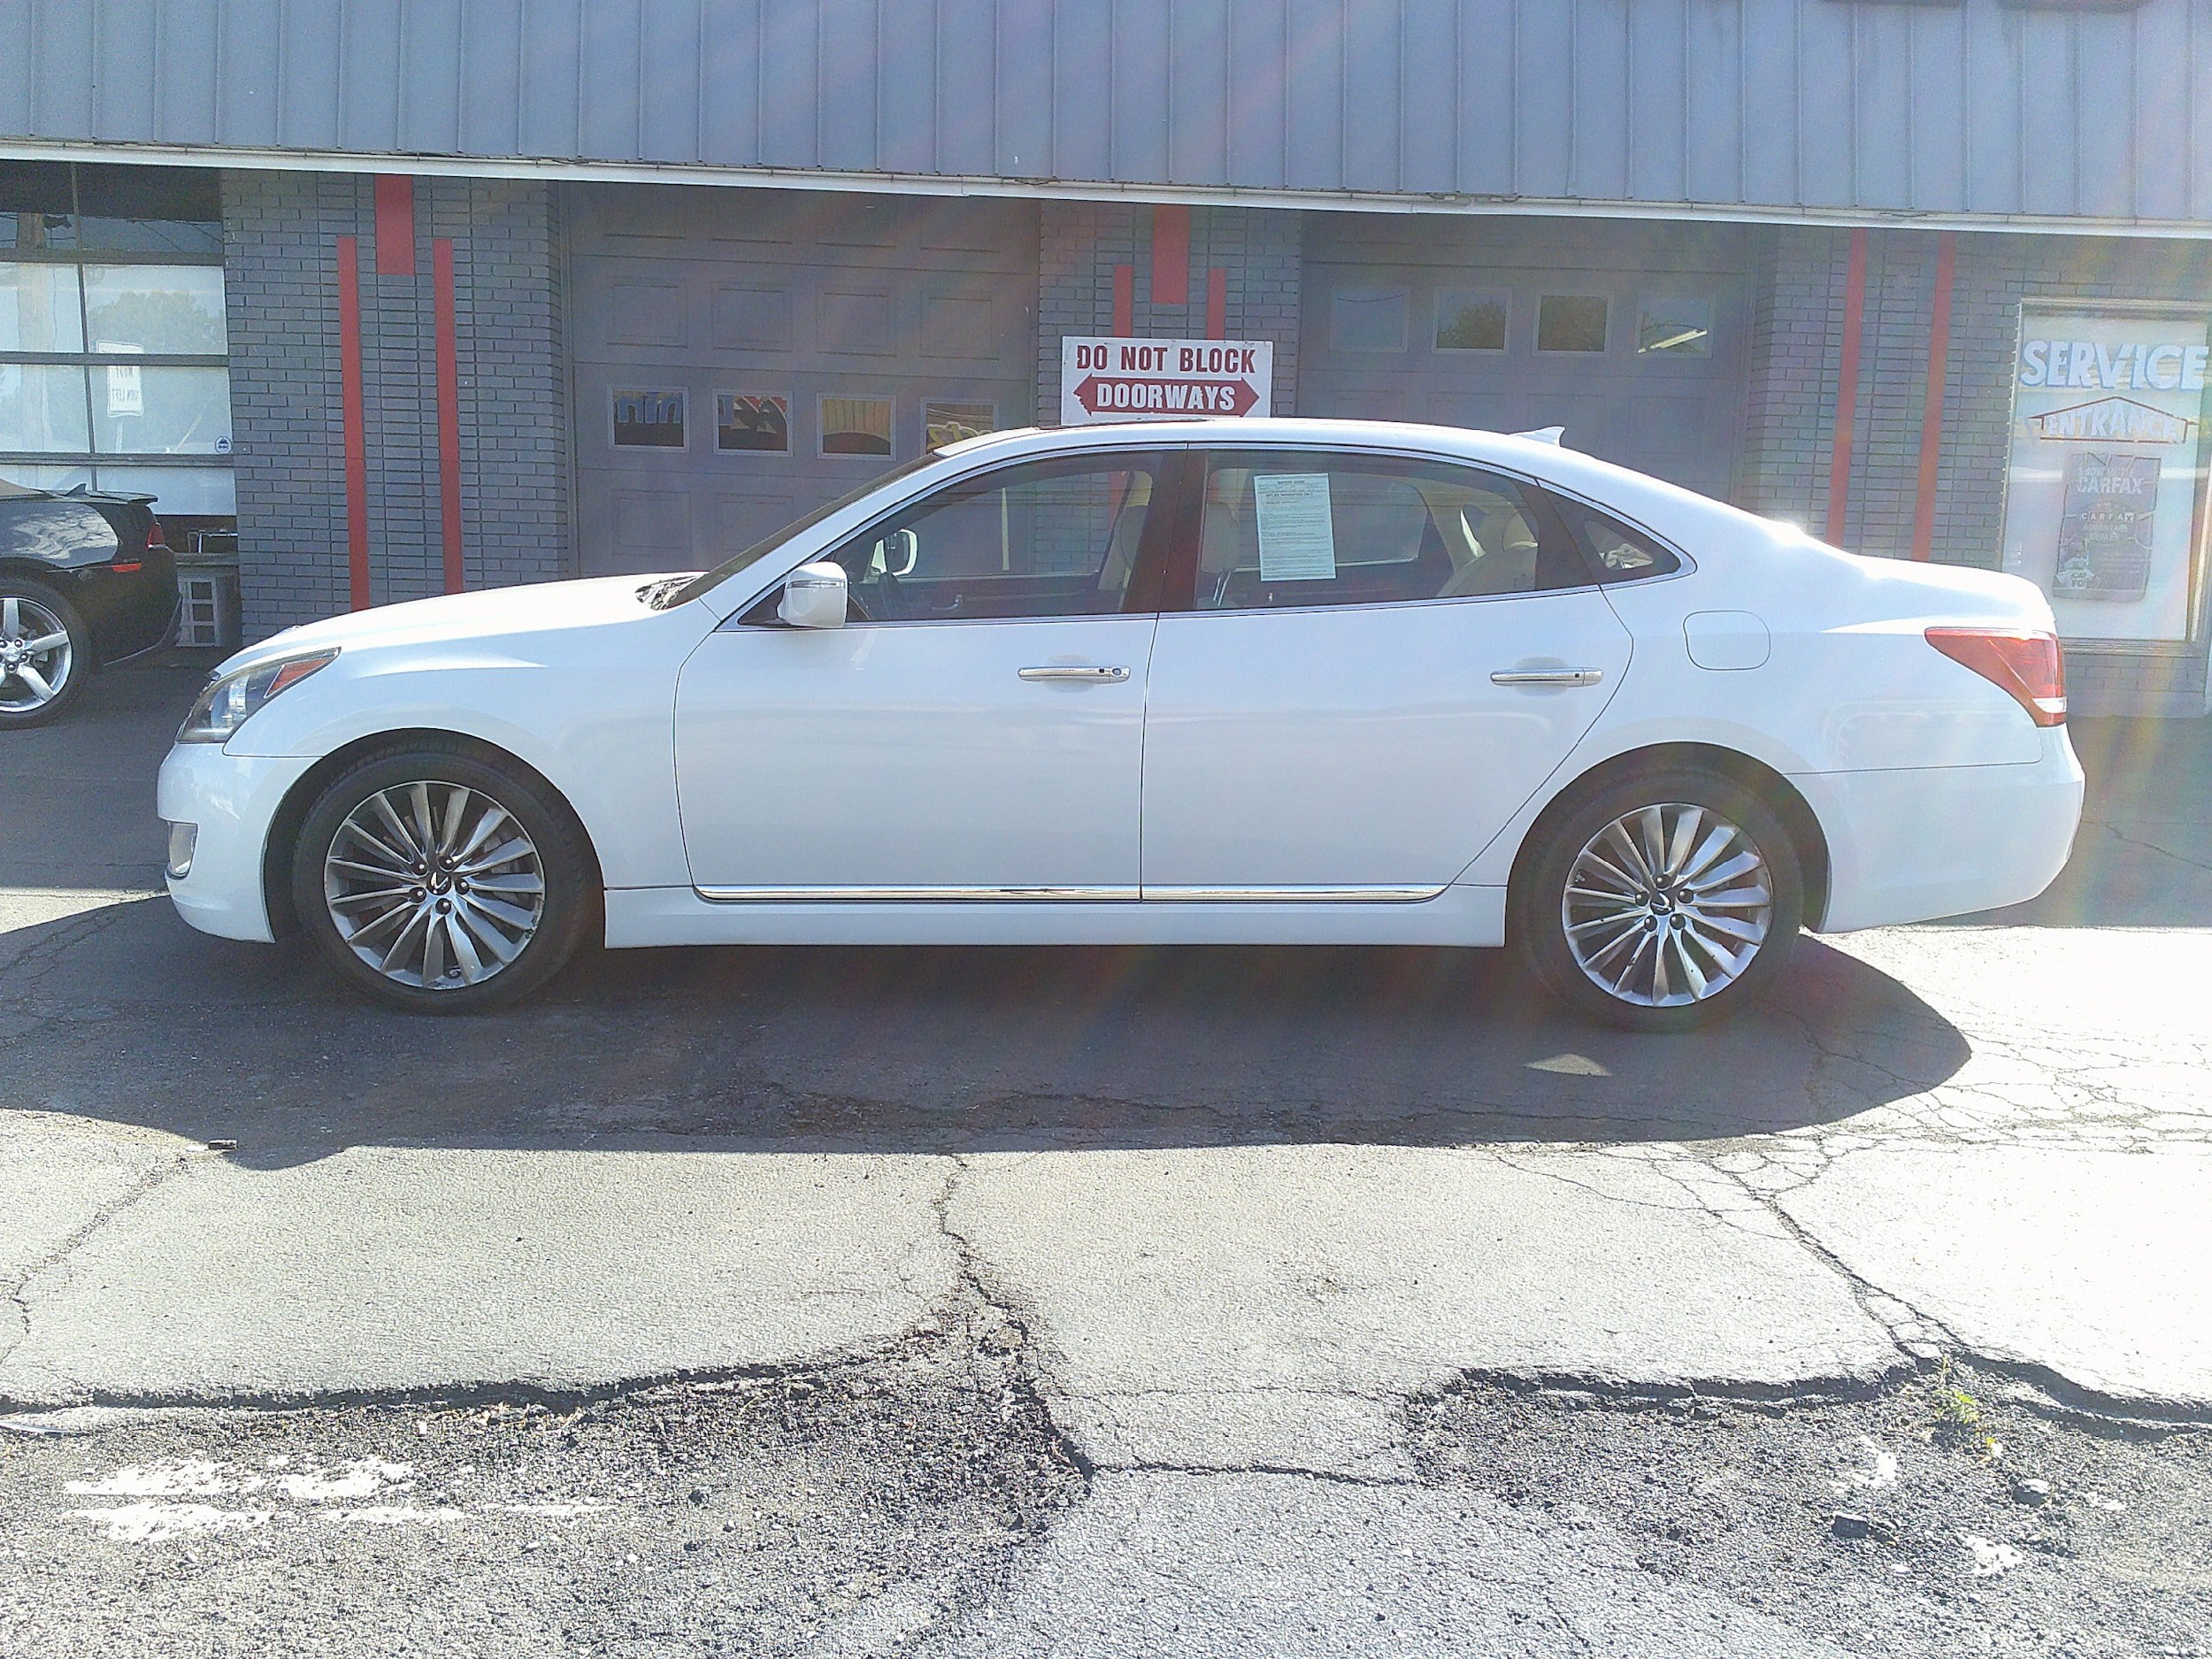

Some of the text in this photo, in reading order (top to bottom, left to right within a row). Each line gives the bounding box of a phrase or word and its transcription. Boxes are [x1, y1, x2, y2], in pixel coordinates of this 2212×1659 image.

[1076, 344, 1256, 374] DO NOT BLOCK
[2018, 340, 2210, 391] SERVICE
[1096, 382, 1236, 411] DOORWAYS
[2046, 401, 2177, 439] ENTRANCE
[2077, 477, 2145, 495] CARFAX
